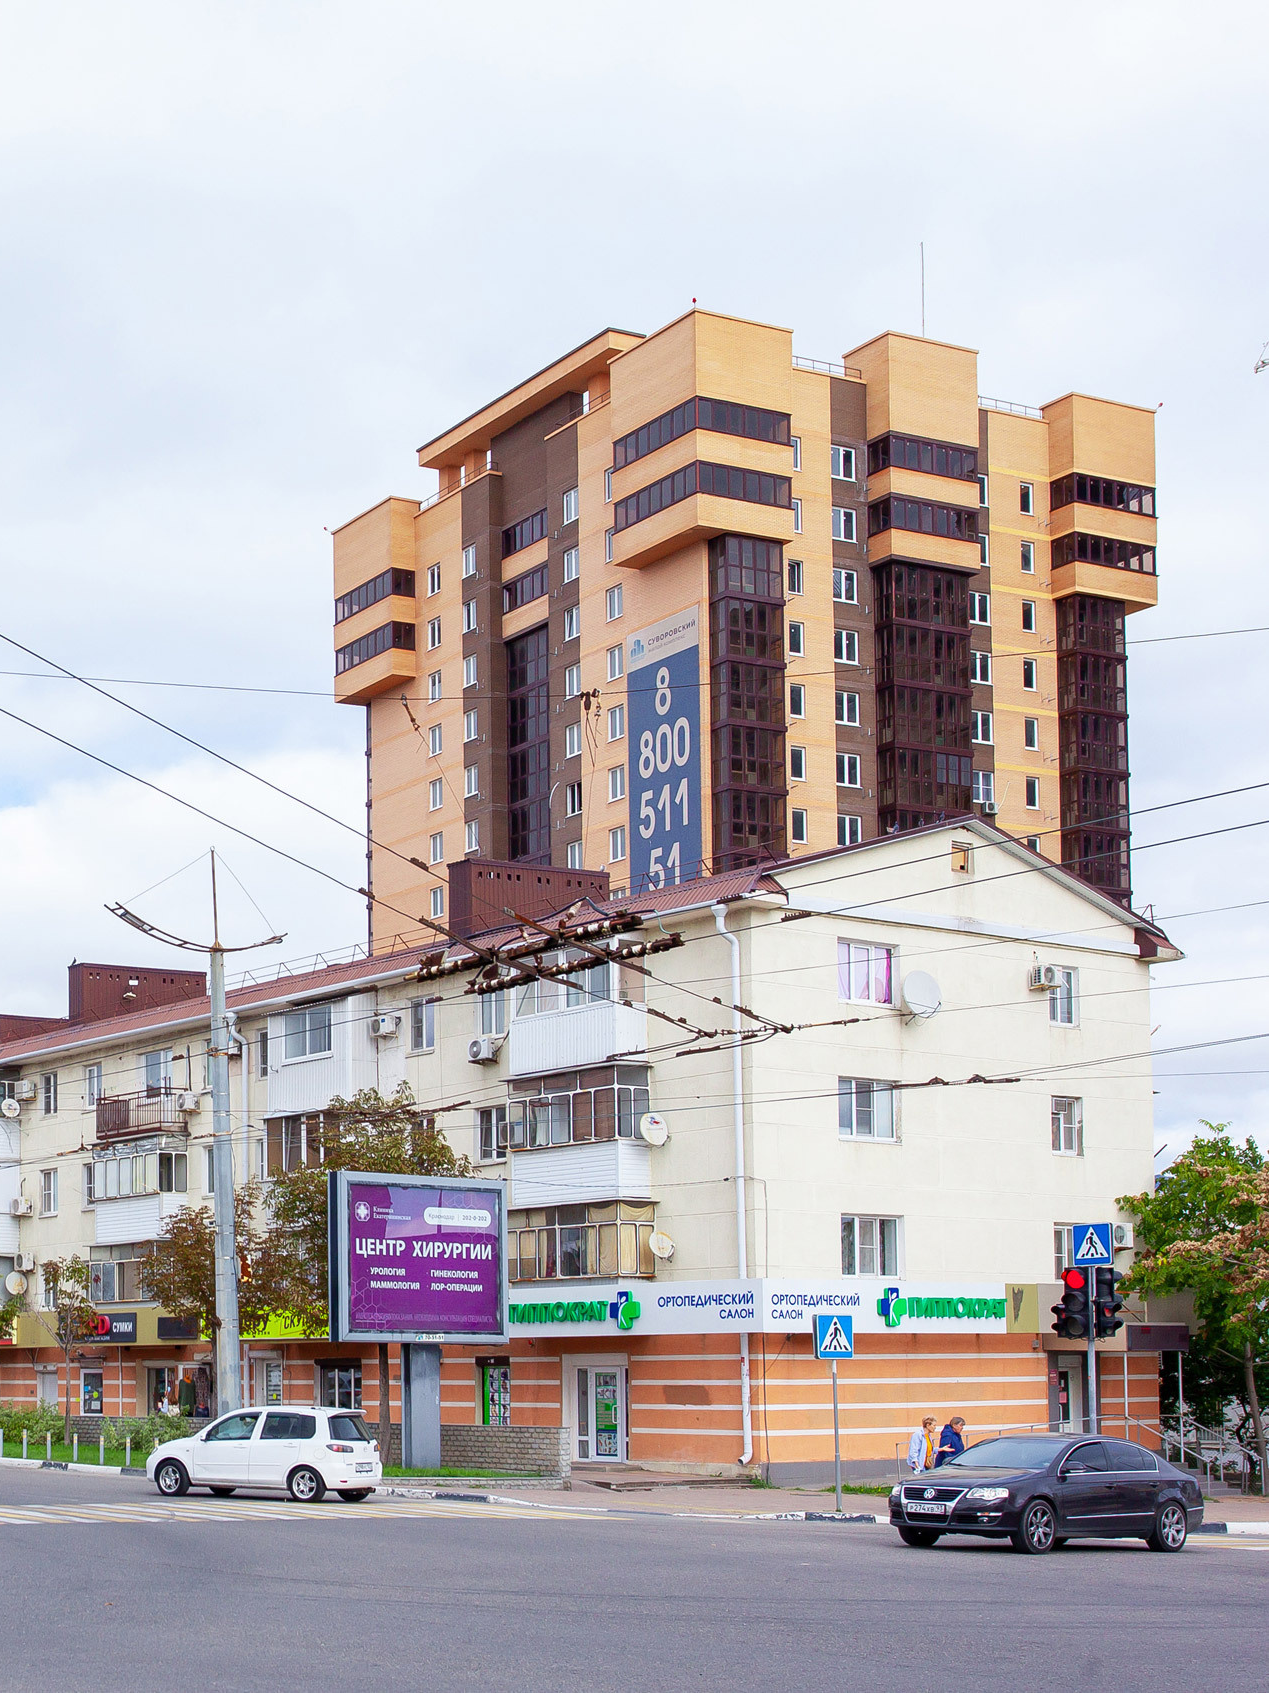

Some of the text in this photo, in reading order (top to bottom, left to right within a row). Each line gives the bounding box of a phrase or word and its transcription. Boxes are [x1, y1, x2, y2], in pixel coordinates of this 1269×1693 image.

[648, 618, 696, 646] СУВОРОВСКИЙ
[654, 666, 672, 716] 8
[638, 716, 690, 779] 800
[638, 778, 688, 839] 511
[648, 842, 680, 892] 51
[355, 1238, 492, 1260] ЦЕНТР ХИРУРГИИ
[370, 1266, 406, 1276] УРОЛОГИЯ
[430, 1269, 478, 1279] ГИНЕКОЛОГИЯ
[370, 1280, 420, 1290] МАММОЛОГИЯ
[430, 1282, 483, 1293] ЛОР-ОПЕРАЦИИ
[657, 1290, 754, 1308] ОРТОПЕДИЧЕСКИЙ
[771, 1292, 860, 1308] ОРТОПЕДИЧЕСКИЙ
[907, 1296, 1008, 1320] ГИППОКРАТ
[508, 1300, 609, 1324] ГИППОКРАТ
[719, 1308, 754, 1320] САЛОН
[771, 1309, 804, 1320] САЛОН
[112, 1322, 133, 1332] СУМКИ
